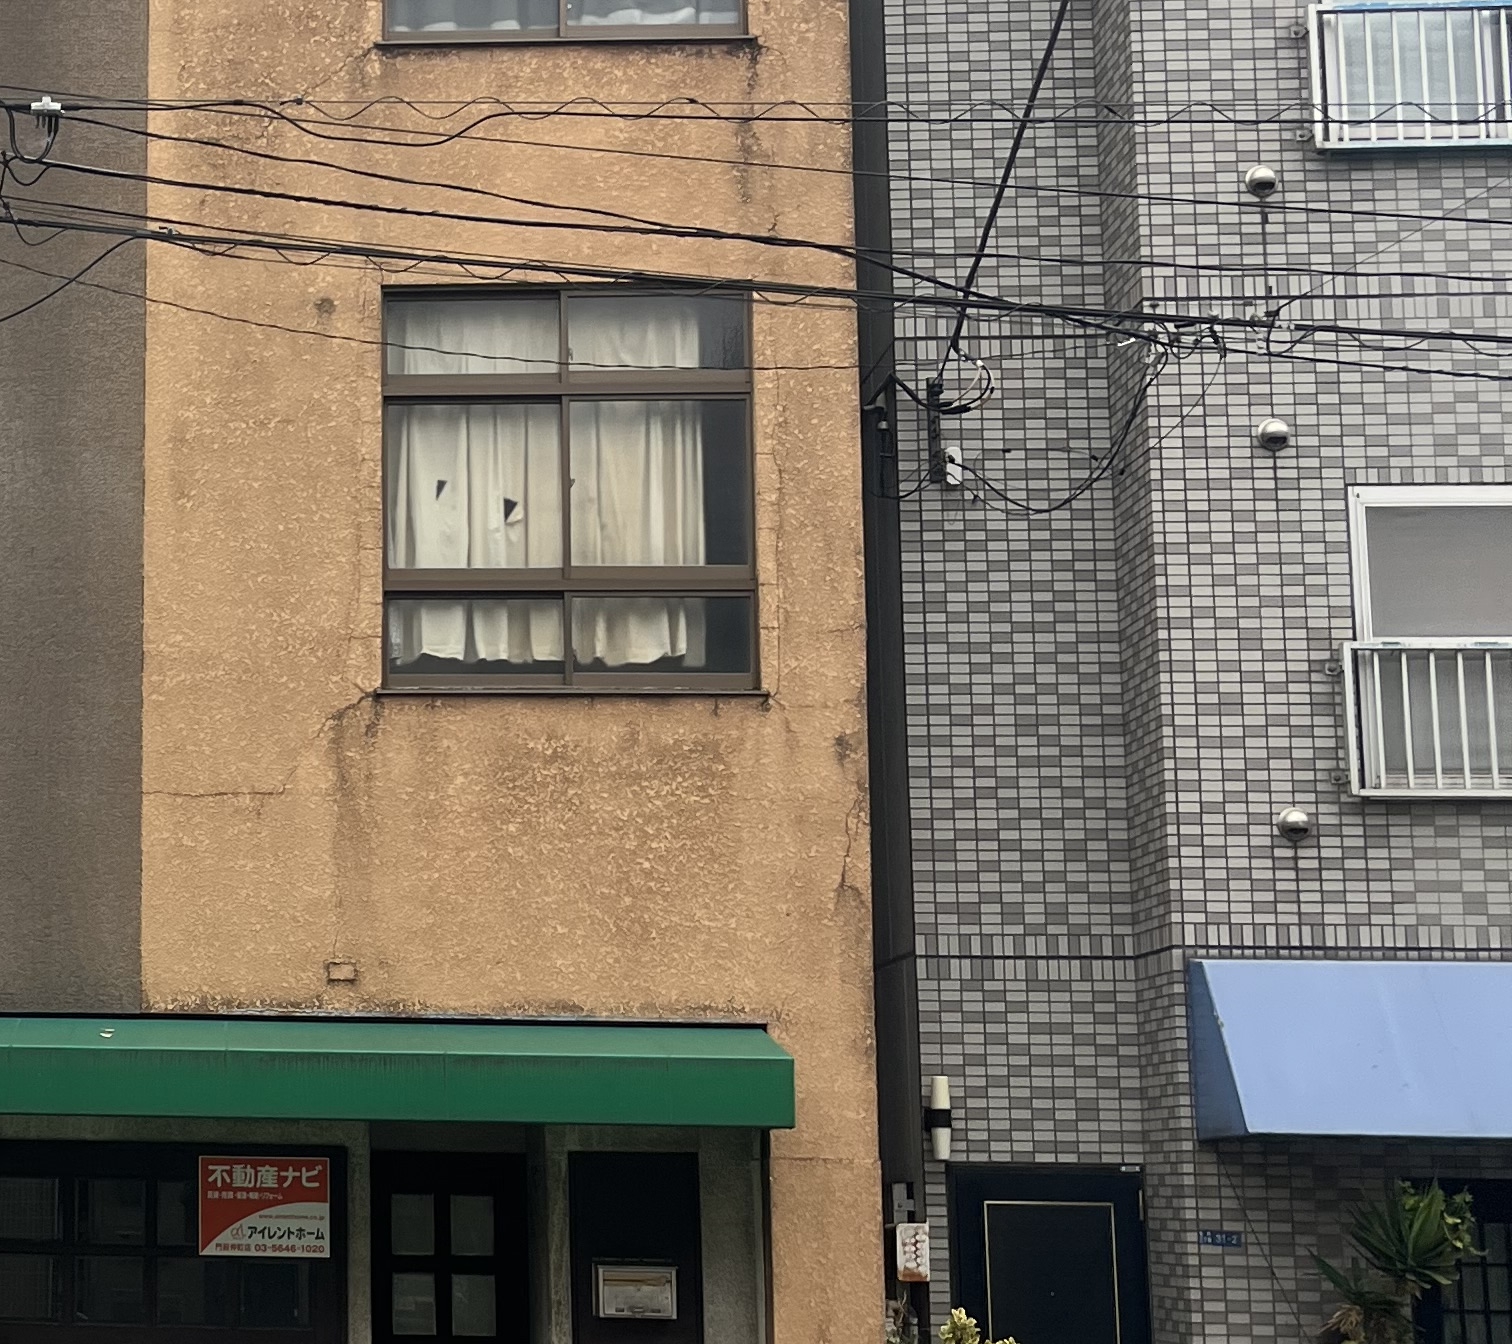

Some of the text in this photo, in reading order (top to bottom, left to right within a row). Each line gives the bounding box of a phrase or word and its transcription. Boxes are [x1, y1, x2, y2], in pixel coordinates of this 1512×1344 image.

[207, 1164, 323, 1188] 不動産ナビ
[247, 1226, 325, 1240] アイレントホーム
[254, 1244, 325, 1253] 03-5646-1020
